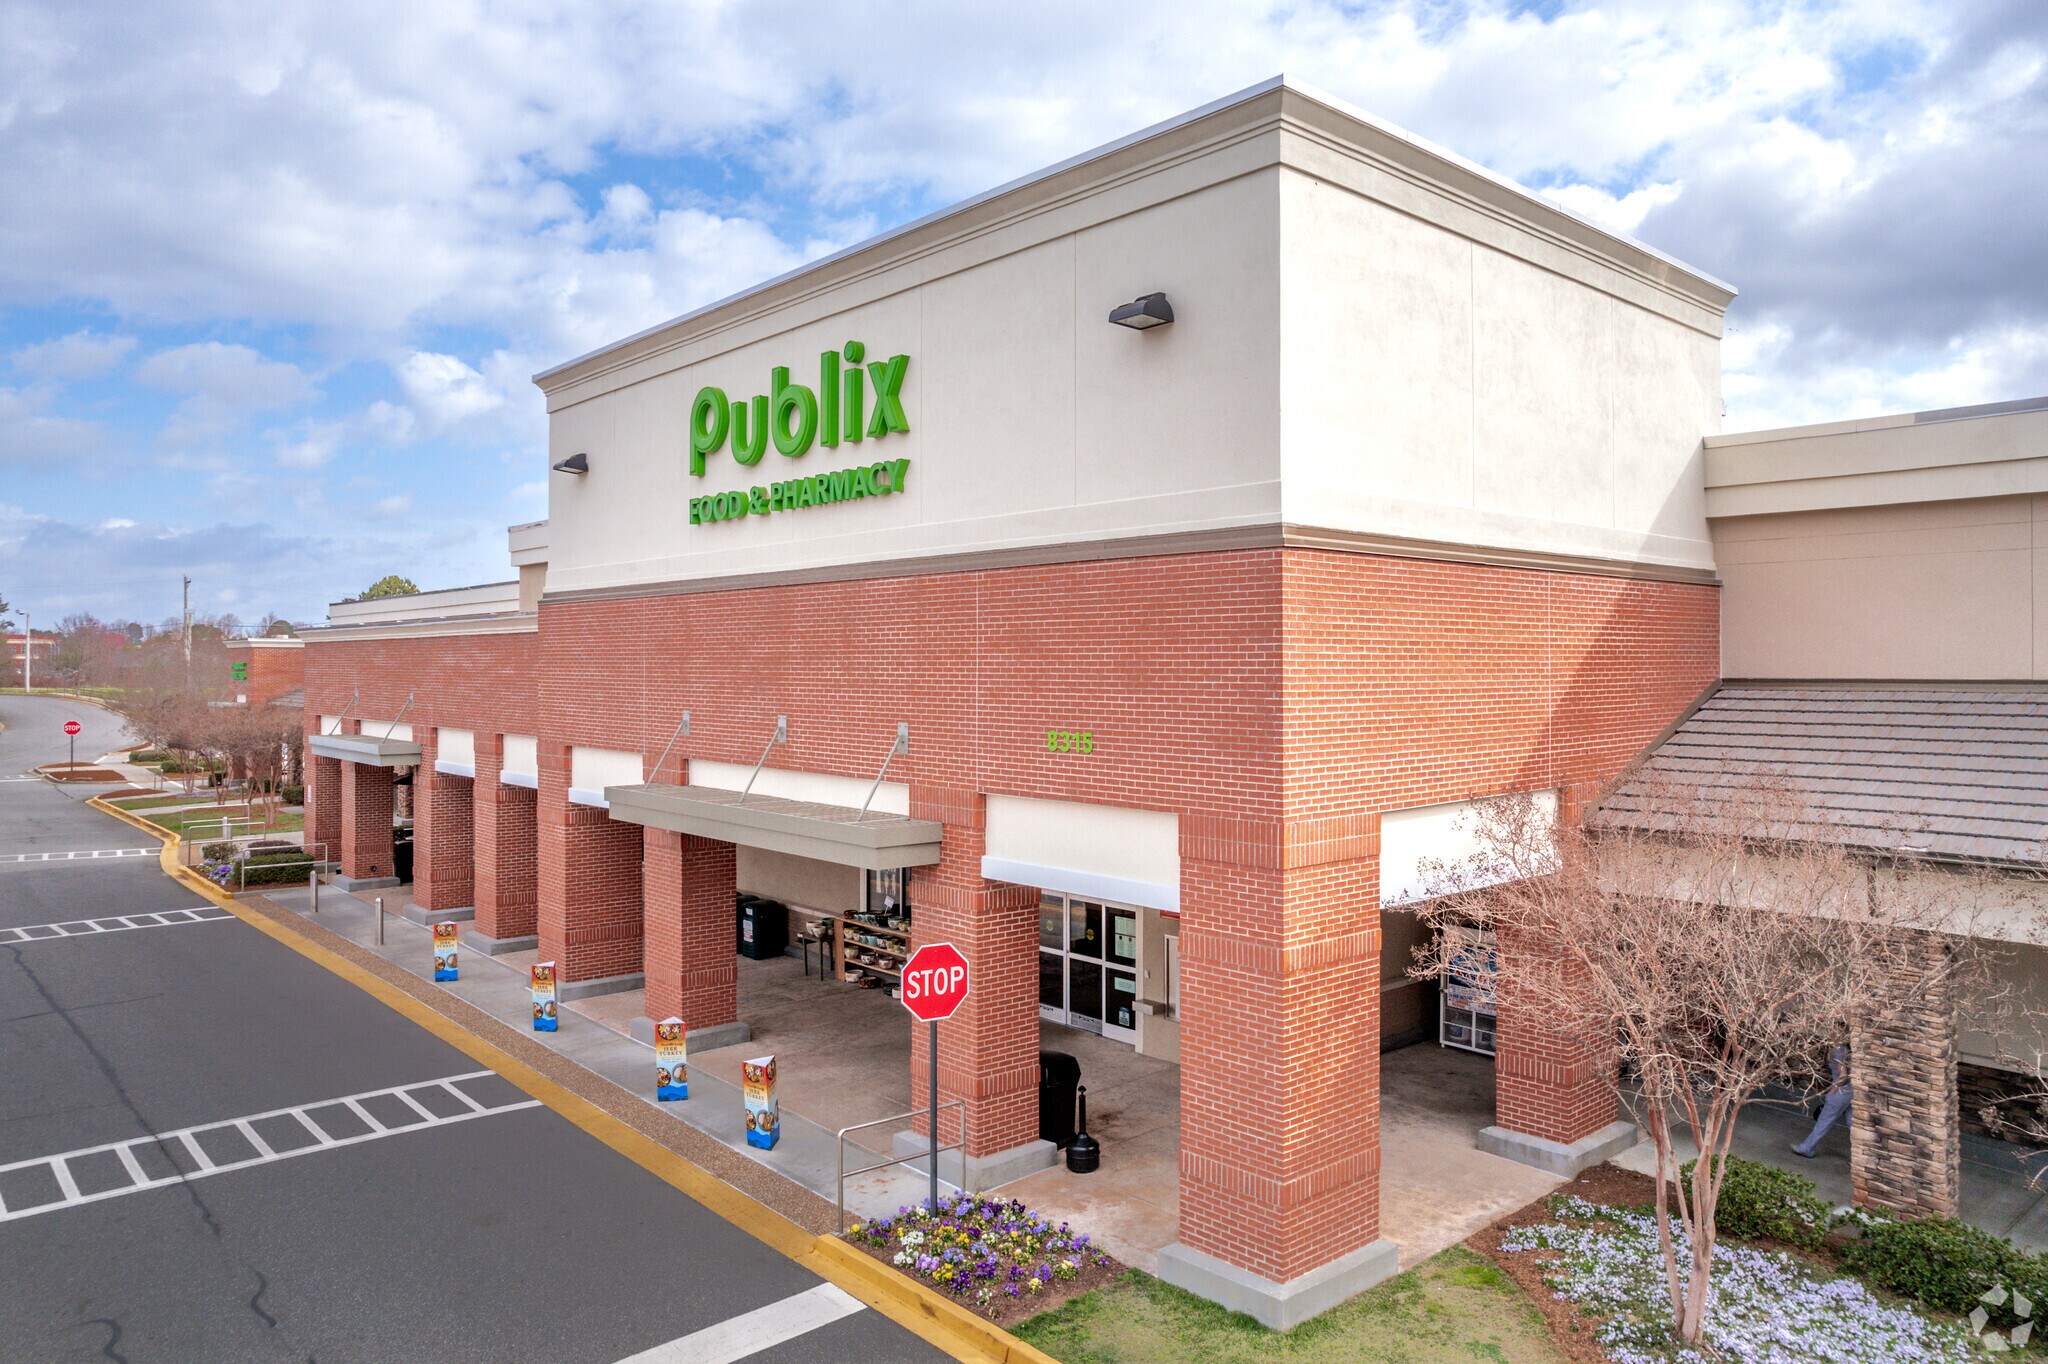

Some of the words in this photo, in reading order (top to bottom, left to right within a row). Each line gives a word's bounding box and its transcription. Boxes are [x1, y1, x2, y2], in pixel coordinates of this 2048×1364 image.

[690, 491, 749, 525] FOOD
[749, 486, 771, 515] &
[770, 458, 911, 512] PHARMACY
[64, 724, 81, 732] STOP
[1047, 730, 1094, 754] 8315
[906, 965, 965, 999] STOP
